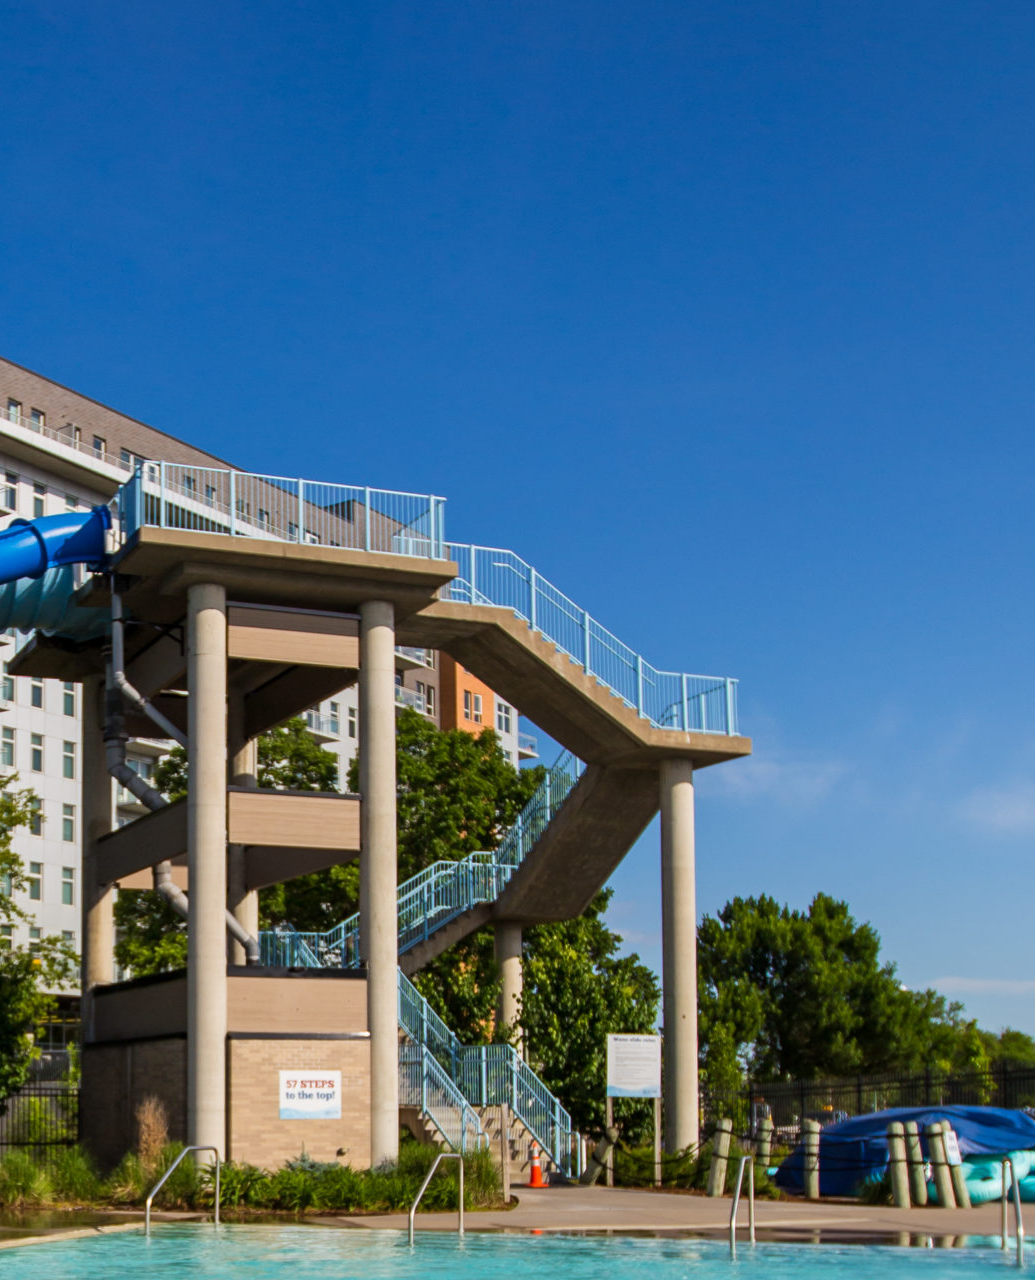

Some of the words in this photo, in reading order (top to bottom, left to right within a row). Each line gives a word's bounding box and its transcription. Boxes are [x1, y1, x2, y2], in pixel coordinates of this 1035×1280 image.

[286, 1080, 298, 1088] 57
[300, 1080, 335, 1088] STEPS
[286, 1091, 296, 1100] to
[297, 1090, 314, 1100] the
[316, 1090, 336, 1102] top!
